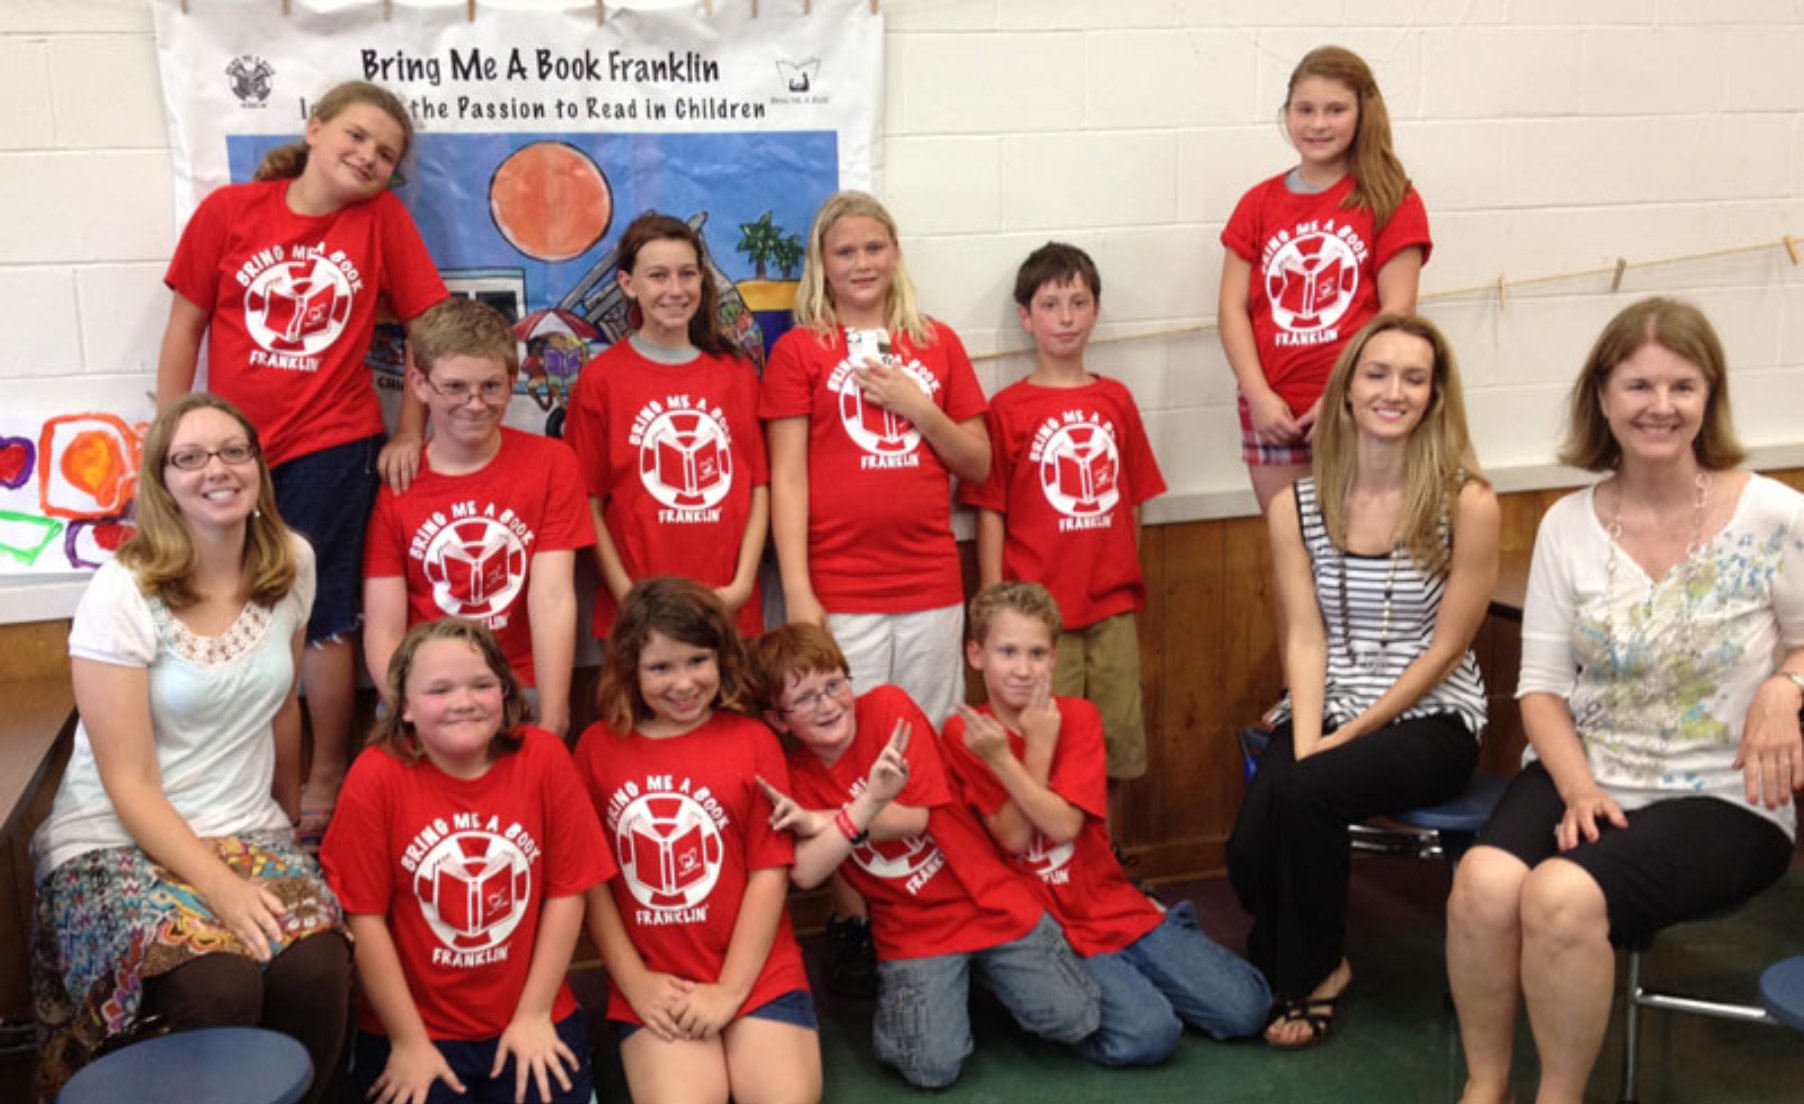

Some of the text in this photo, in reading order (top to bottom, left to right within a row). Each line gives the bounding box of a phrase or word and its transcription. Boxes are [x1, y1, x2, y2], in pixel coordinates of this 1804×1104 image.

[361, 47, 720, 86] Bring Me A Book Franklin
[409, 96, 766, 120] the Passion to Read in Children
[1296, 220, 1318, 235] ME
[1322, 217, 1335, 233] A
[1337, 224, 1369, 265] BOOK
[235, 240, 364, 295] BRING ME A BOOK
[1276, 328, 1339, 346] FRANKLIN
[249, 349, 321, 373] FRANKLIN
[826, 358, 852, 393] BRIN
[907, 358, 942, 394] BOOK
[628, 399, 664, 446] BRING
[666, 393, 691, 410] ME
[695, 396, 708, 412] A
[1028, 408, 1101, 463] BRING ME A
[860, 452, 920, 471] FRANKLIN
[409, 499, 535, 561] BRING ME A BOOK
[657, 507, 722, 525] FRANKLIN
[1058, 515, 1114, 533] FRANKLIN
[646, 774, 673, 791] ME
[678, 776, 692, 794] A
[692, 785, 732, 832] BOOK
[400, 811, 542, 874] BRING ME A BOOK
[635, 908, 708, 926] FRANKLIN
[432, 946, 509, 968] FRANKLIN
